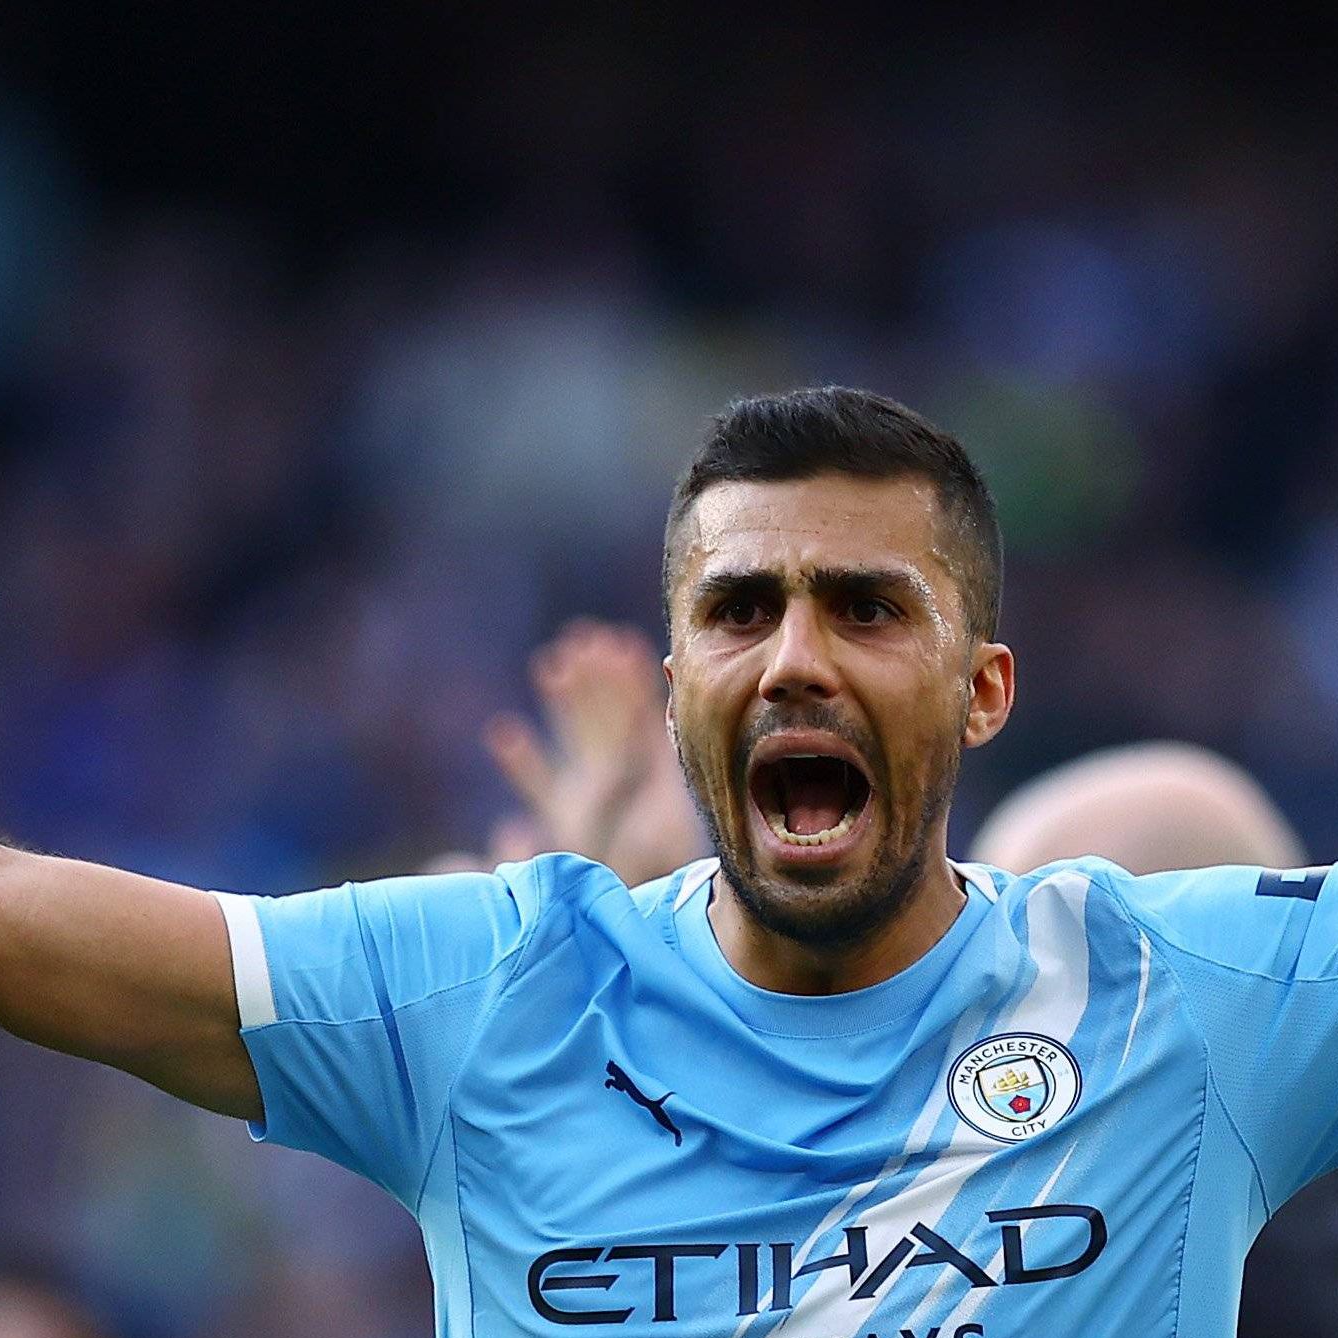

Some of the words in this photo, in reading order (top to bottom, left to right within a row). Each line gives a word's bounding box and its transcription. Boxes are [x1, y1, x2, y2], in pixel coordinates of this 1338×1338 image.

[958, 1041, 1058, 1085] MANCHESTER
[1012, 1119, 1047, 1137] CITY
[527, 1203, 1108, 1325] ETIHAD
